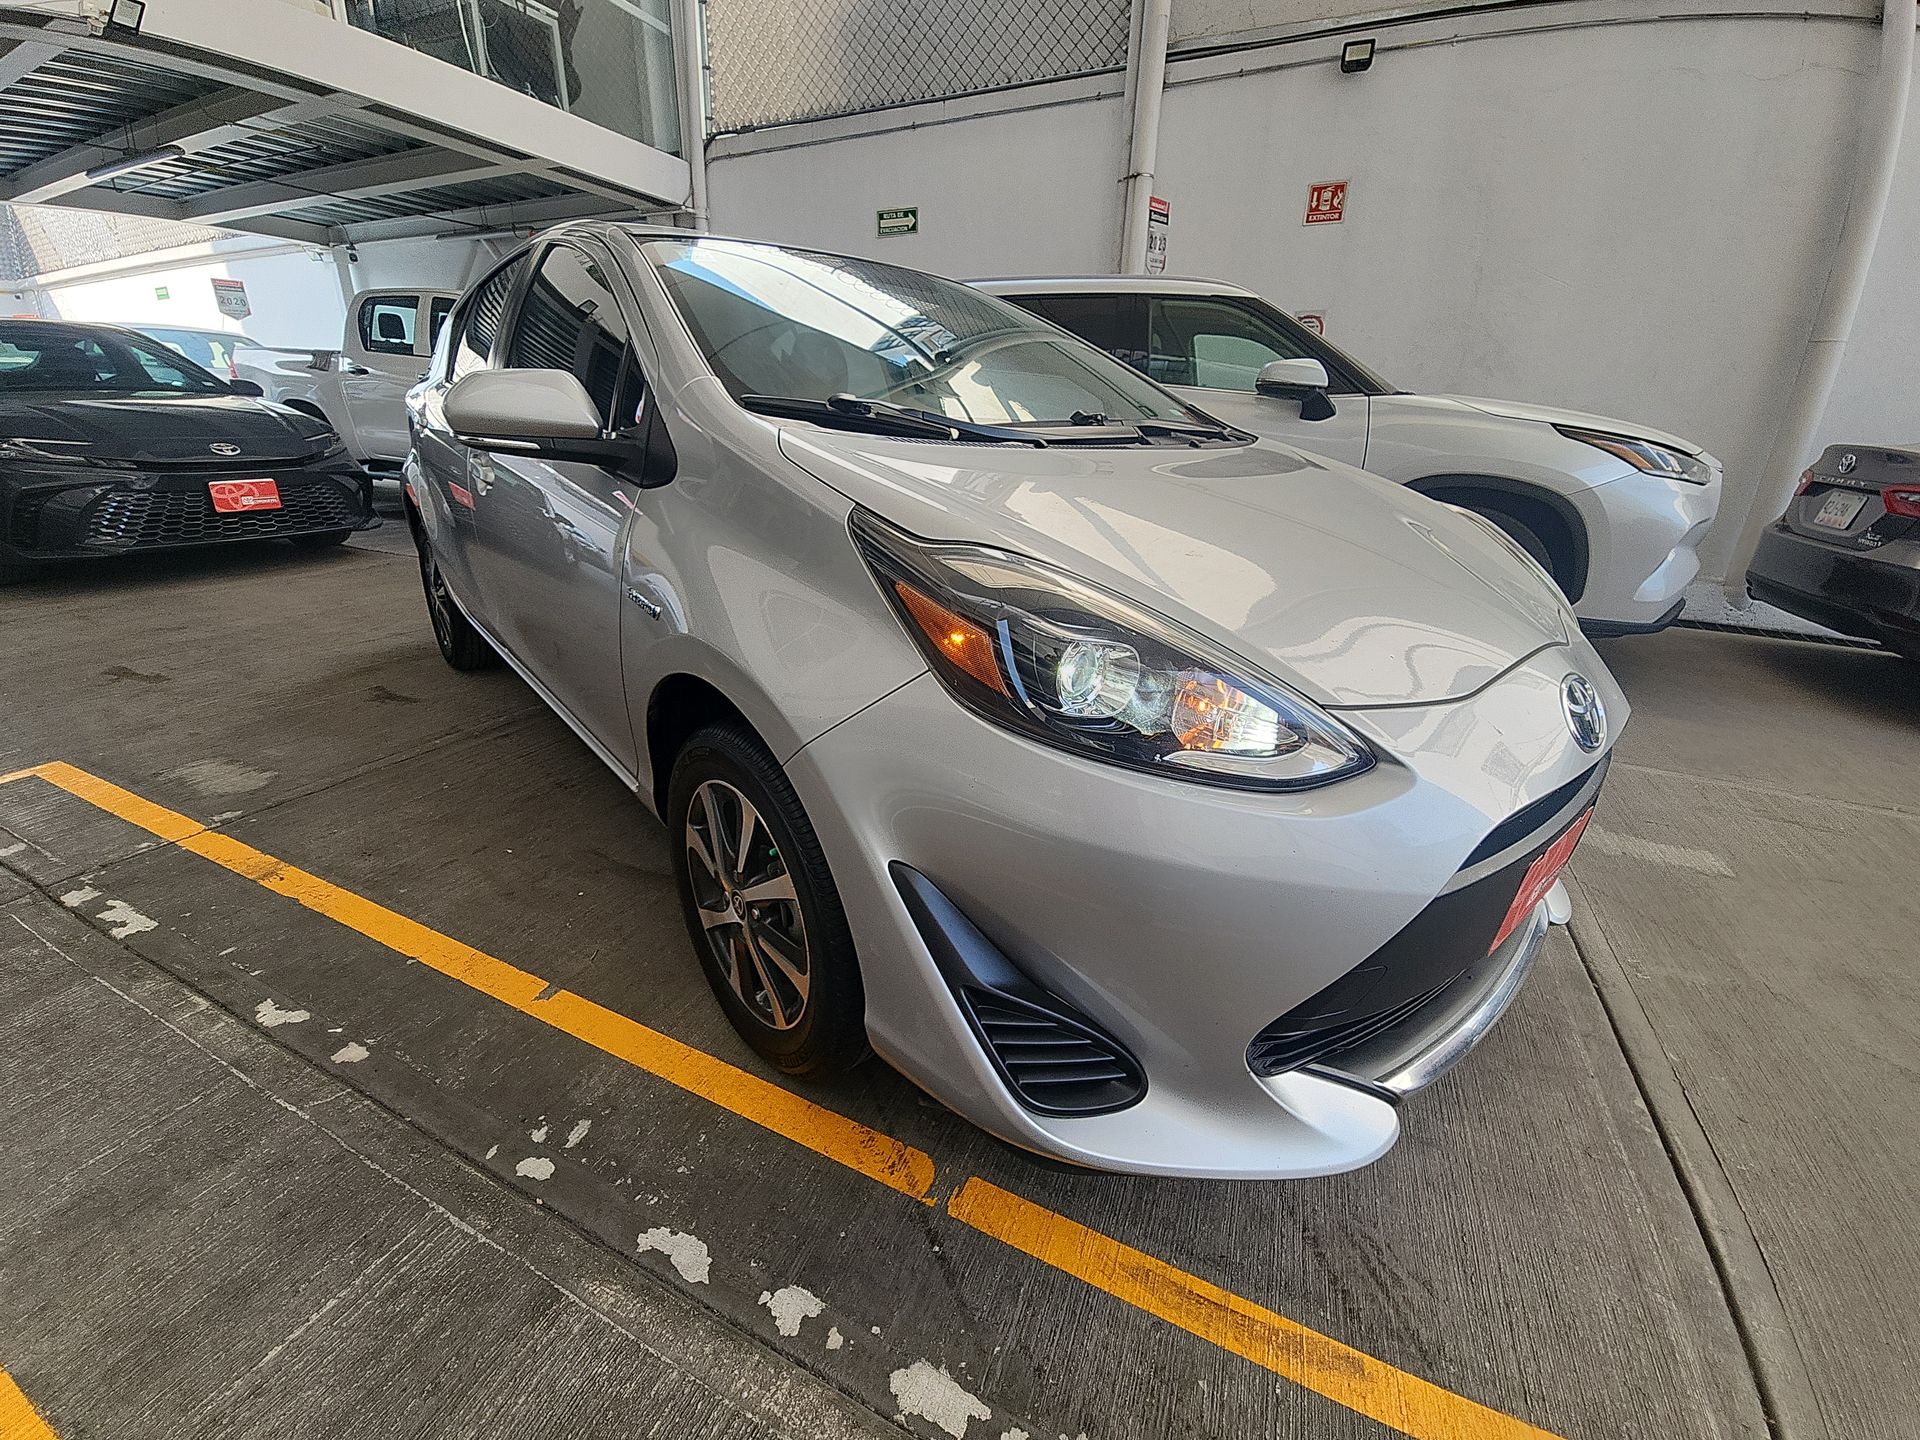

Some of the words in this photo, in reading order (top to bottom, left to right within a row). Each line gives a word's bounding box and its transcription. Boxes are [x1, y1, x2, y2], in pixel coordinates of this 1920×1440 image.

[1308, 212, 1340, 221] EXTINTOR
[1148, 233, 1167, 251] 2023
[219, 295, 247, 307] 2020
